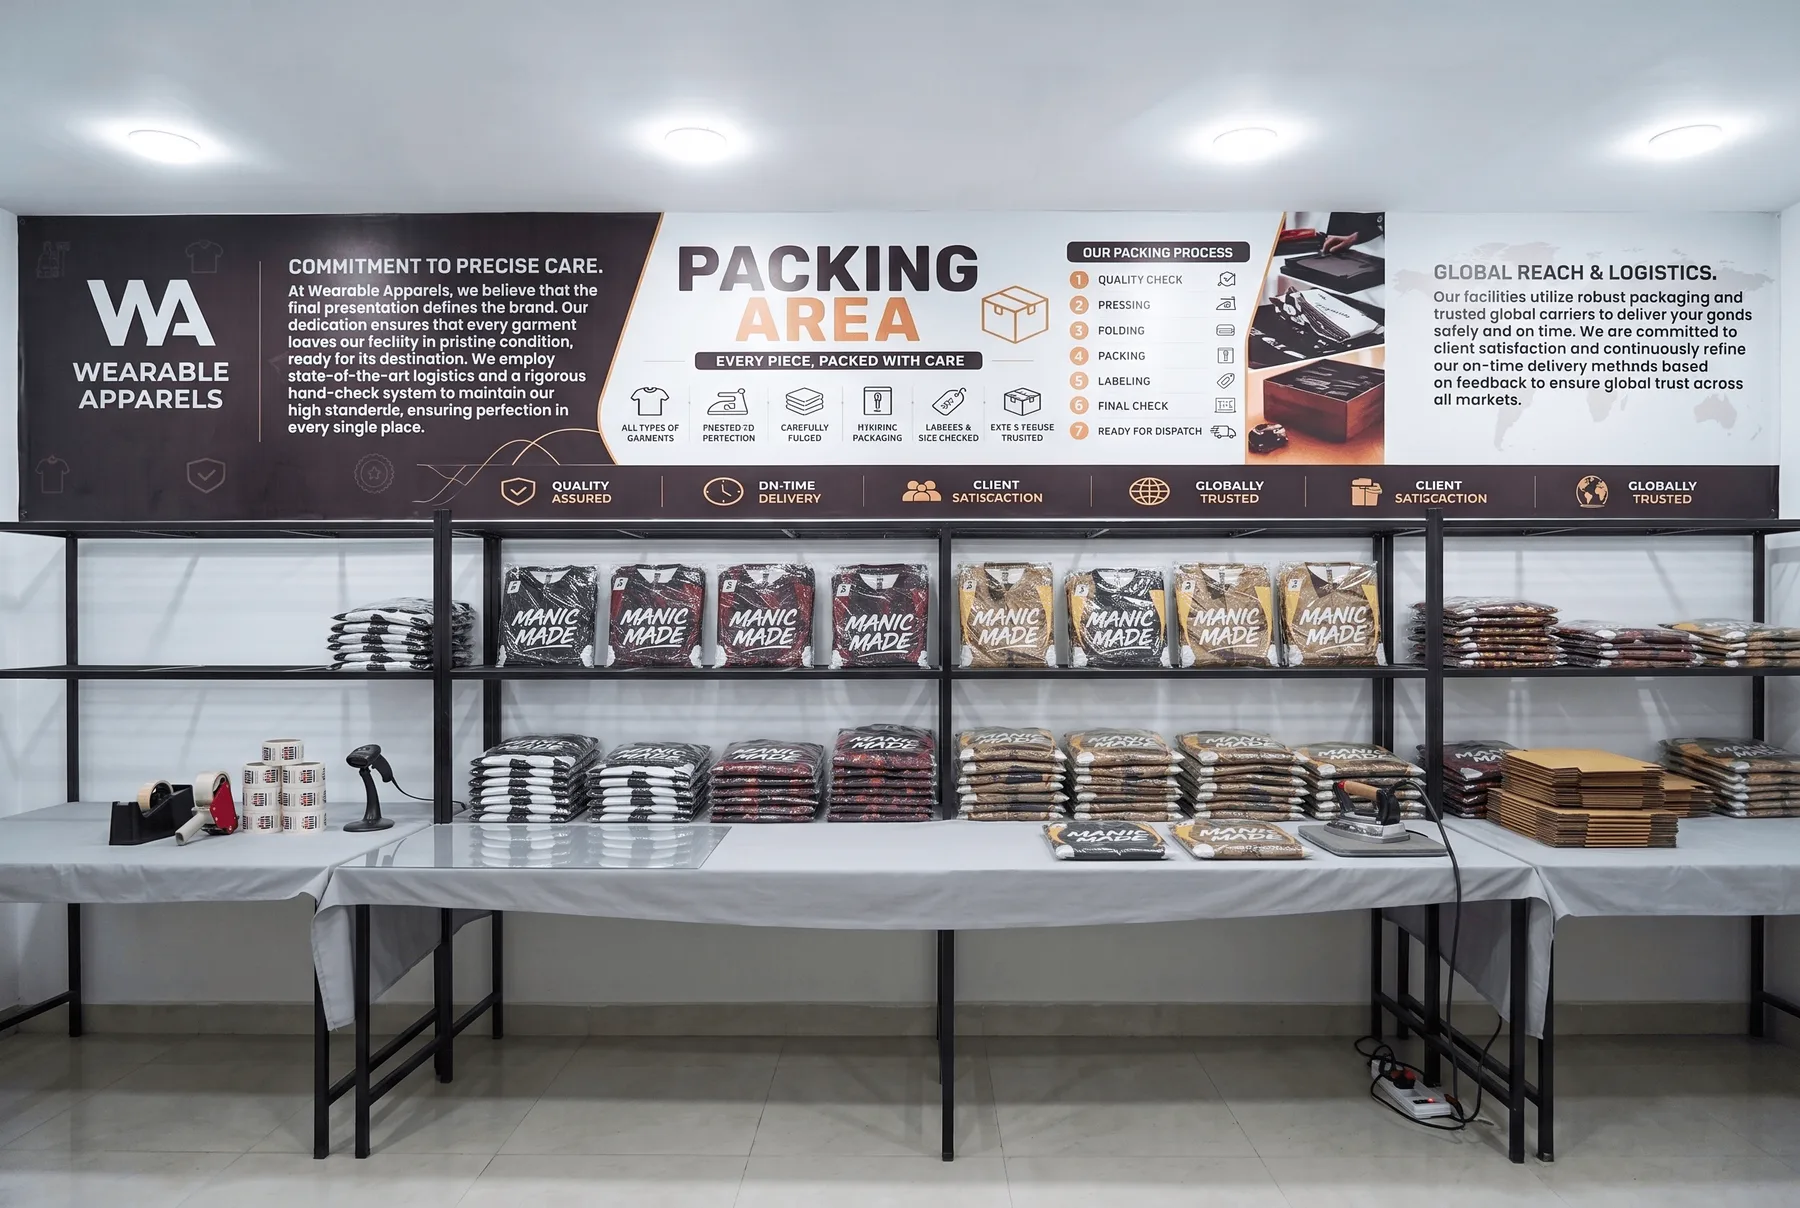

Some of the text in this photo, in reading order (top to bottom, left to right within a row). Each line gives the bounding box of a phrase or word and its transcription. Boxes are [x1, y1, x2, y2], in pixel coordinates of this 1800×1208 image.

[1084, 248, 1233, 258] OUR PACKING PROCESS
[290, 258, 603, 274] COMMITMENT TO PRECISE CARE.
[679, 245, 978, 292] PACKING
[1434, 264, 1716, 280] GLOBAL REACH & LOGISTICS.
[1099, 275, 1182, 286] QUALITY CHECK
[288, 283, 598, 301] At Wearable Apparels, we believe that the
[1434, 290, 1742, 307] Our facilities utilize robust packaging and
[87, 280, 216, 346] WA
[288, 300, 588, 318] final presentation defines the brand. Our
[1099, 301, 1150, 309] PRESSING
[736, 297, 920, 342] AREA
[1434, 308, 1752, 324] trusted global carriers to deliver your gonds
[288, 318, 576, 335] dedication ensures that every garment
[1099, 326, 1144, 335] FOLDING
[1434, 324, 1737, 341] safely and on time. We are committed to
[340, 338, 365, 348] our
[423, 335, 436, 348] in
[440, 335, 496, 352] pristine
[500, 334, 573, 349] condition,
[1434, 342, 1746, 359] client satisfaction and continuously refine
[289, 352, 555, 369] ready for its destination. We employ
[717, 356, 964, 368] EVERY PIECE, PACKED WITH CARE
[1099, 352, 1145, 360] PACKING
[73, 362, 229, 382] WEARABLE
[1434, 362, 1458, 371] our
[1463, 359, 1523, 372] on-time
[1528, 360, 1587, 376] delivery
[1662, 360, 1708, 372] based
[288, 369, 586, 386] state-of-the-art logistics and a rigorous
[1099, 377, 1150, 386] LABELING
[1434, 376, 1743, 393] on feedback to ensure global trust across
[79, 389, 223, 409] APPARELS
[289, 386, 554, 403] hand-check system to maintain our
[1434, 394, 1521, 406] all markets.
[289, 403, 321, 420] high
[408, 403, 472, 420] ensuring
[477, 403, 551, 420] perfection
[556, 404, 568, 416] in
[1099, 402, 1168, 410] FINAL CHECK
[288, 420, 424, 437] every single place.
[622, 424, 679, 432] ALL TYPES OF
[1099, 427, 1202, 435] READY FOR DISPATCH
[853, 434, 902, 442] PACKAGING
[939, 434, 979, 442] CHECKED
[552, 481, 609, 492] QUALITY
[974, 480, 1020, 490] CLIENT
[1196, 481, 1264, 490] GLOBALLY
[1416, 481, 1462, 490] CLIENT
[1628, 482, 1697, 491] GLOBALLY
[552, 494, 612, 503] ASSURED
[759, 494, 821, 503] DELIVERY
[1200, 494, 1259, 504] TRUSTED
[1633, 494, 1692, 504] TRUSTED
[512, 608, 580, 626] MANIC
[845, 614, 914, 631] MANIC
[973, 608, 1040, 626] MANIC
[515, 627, 577, 645] MADE
[849, 632, 913, 651] MADE
[978, 627, 1039, 646] MADE
